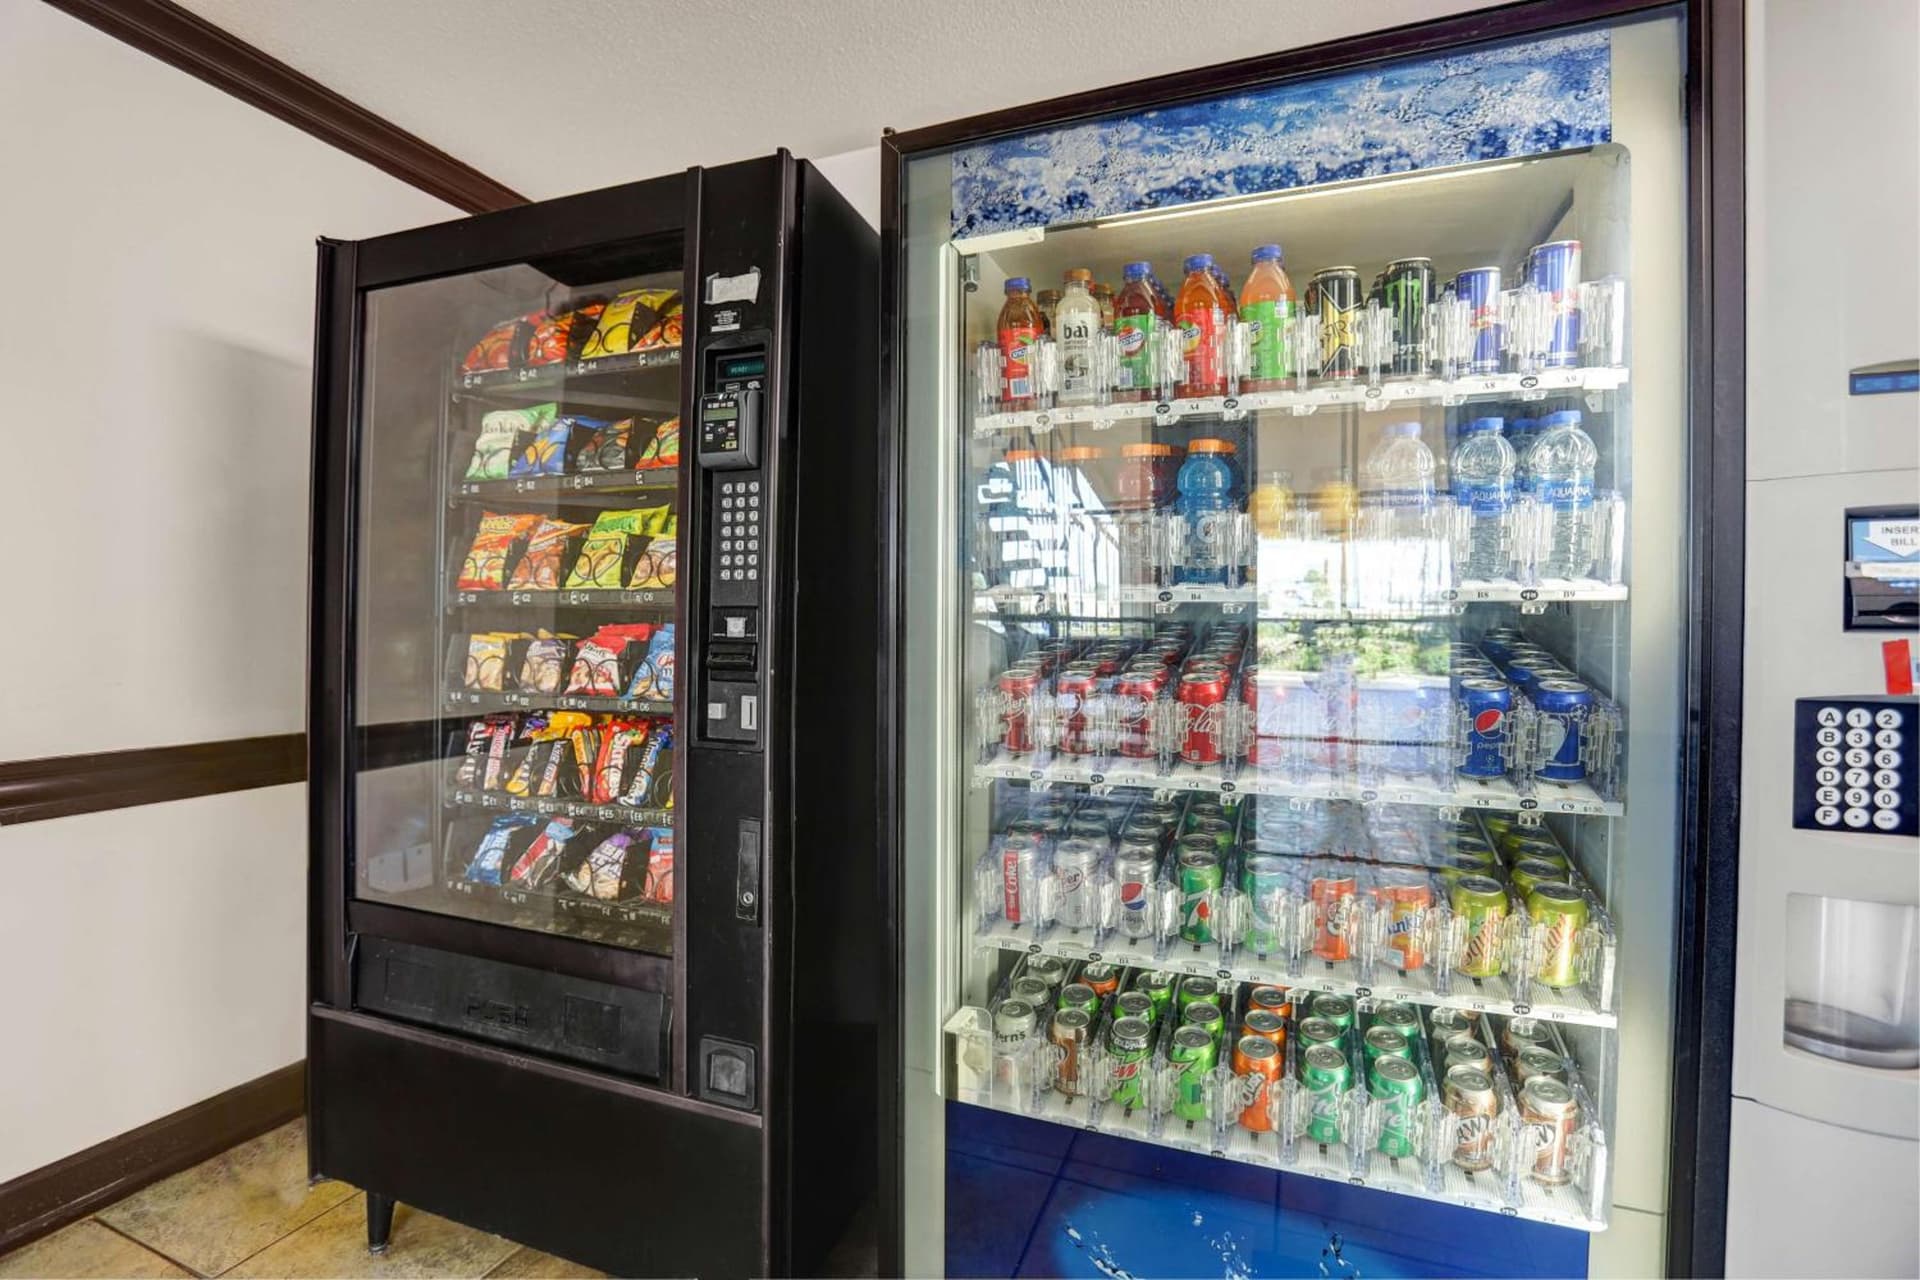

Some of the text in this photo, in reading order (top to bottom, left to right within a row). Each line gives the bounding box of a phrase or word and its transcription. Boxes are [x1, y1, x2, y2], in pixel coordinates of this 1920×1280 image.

[588, 361, 597, 369] A4
[528, 368, 537, 377] A2
[1881, 525, 1919, 535] INSER
[1890, 538, 1918, 546] BILL
[522, 593, 531, 602] C2
[580, 593, 589, 602] C4
[644, 592, 654, 601] C6
[577, 700, 587, 709] D4
[639, 702, 650, 712] D6
[1824, 712, 1893, 725] A 1 2
[1823, 731, 1892, 745] B 3 4
[1823, 751, 1891, 765] C 5 6
[1823, 771, 1891, 785] D 7 8
[1823, 791, 1891, 805] E 9 0
[575, 806, 584, 815] E4
[605, 809, 614, 818] E5
[1822, 810, 1832, 820] F
